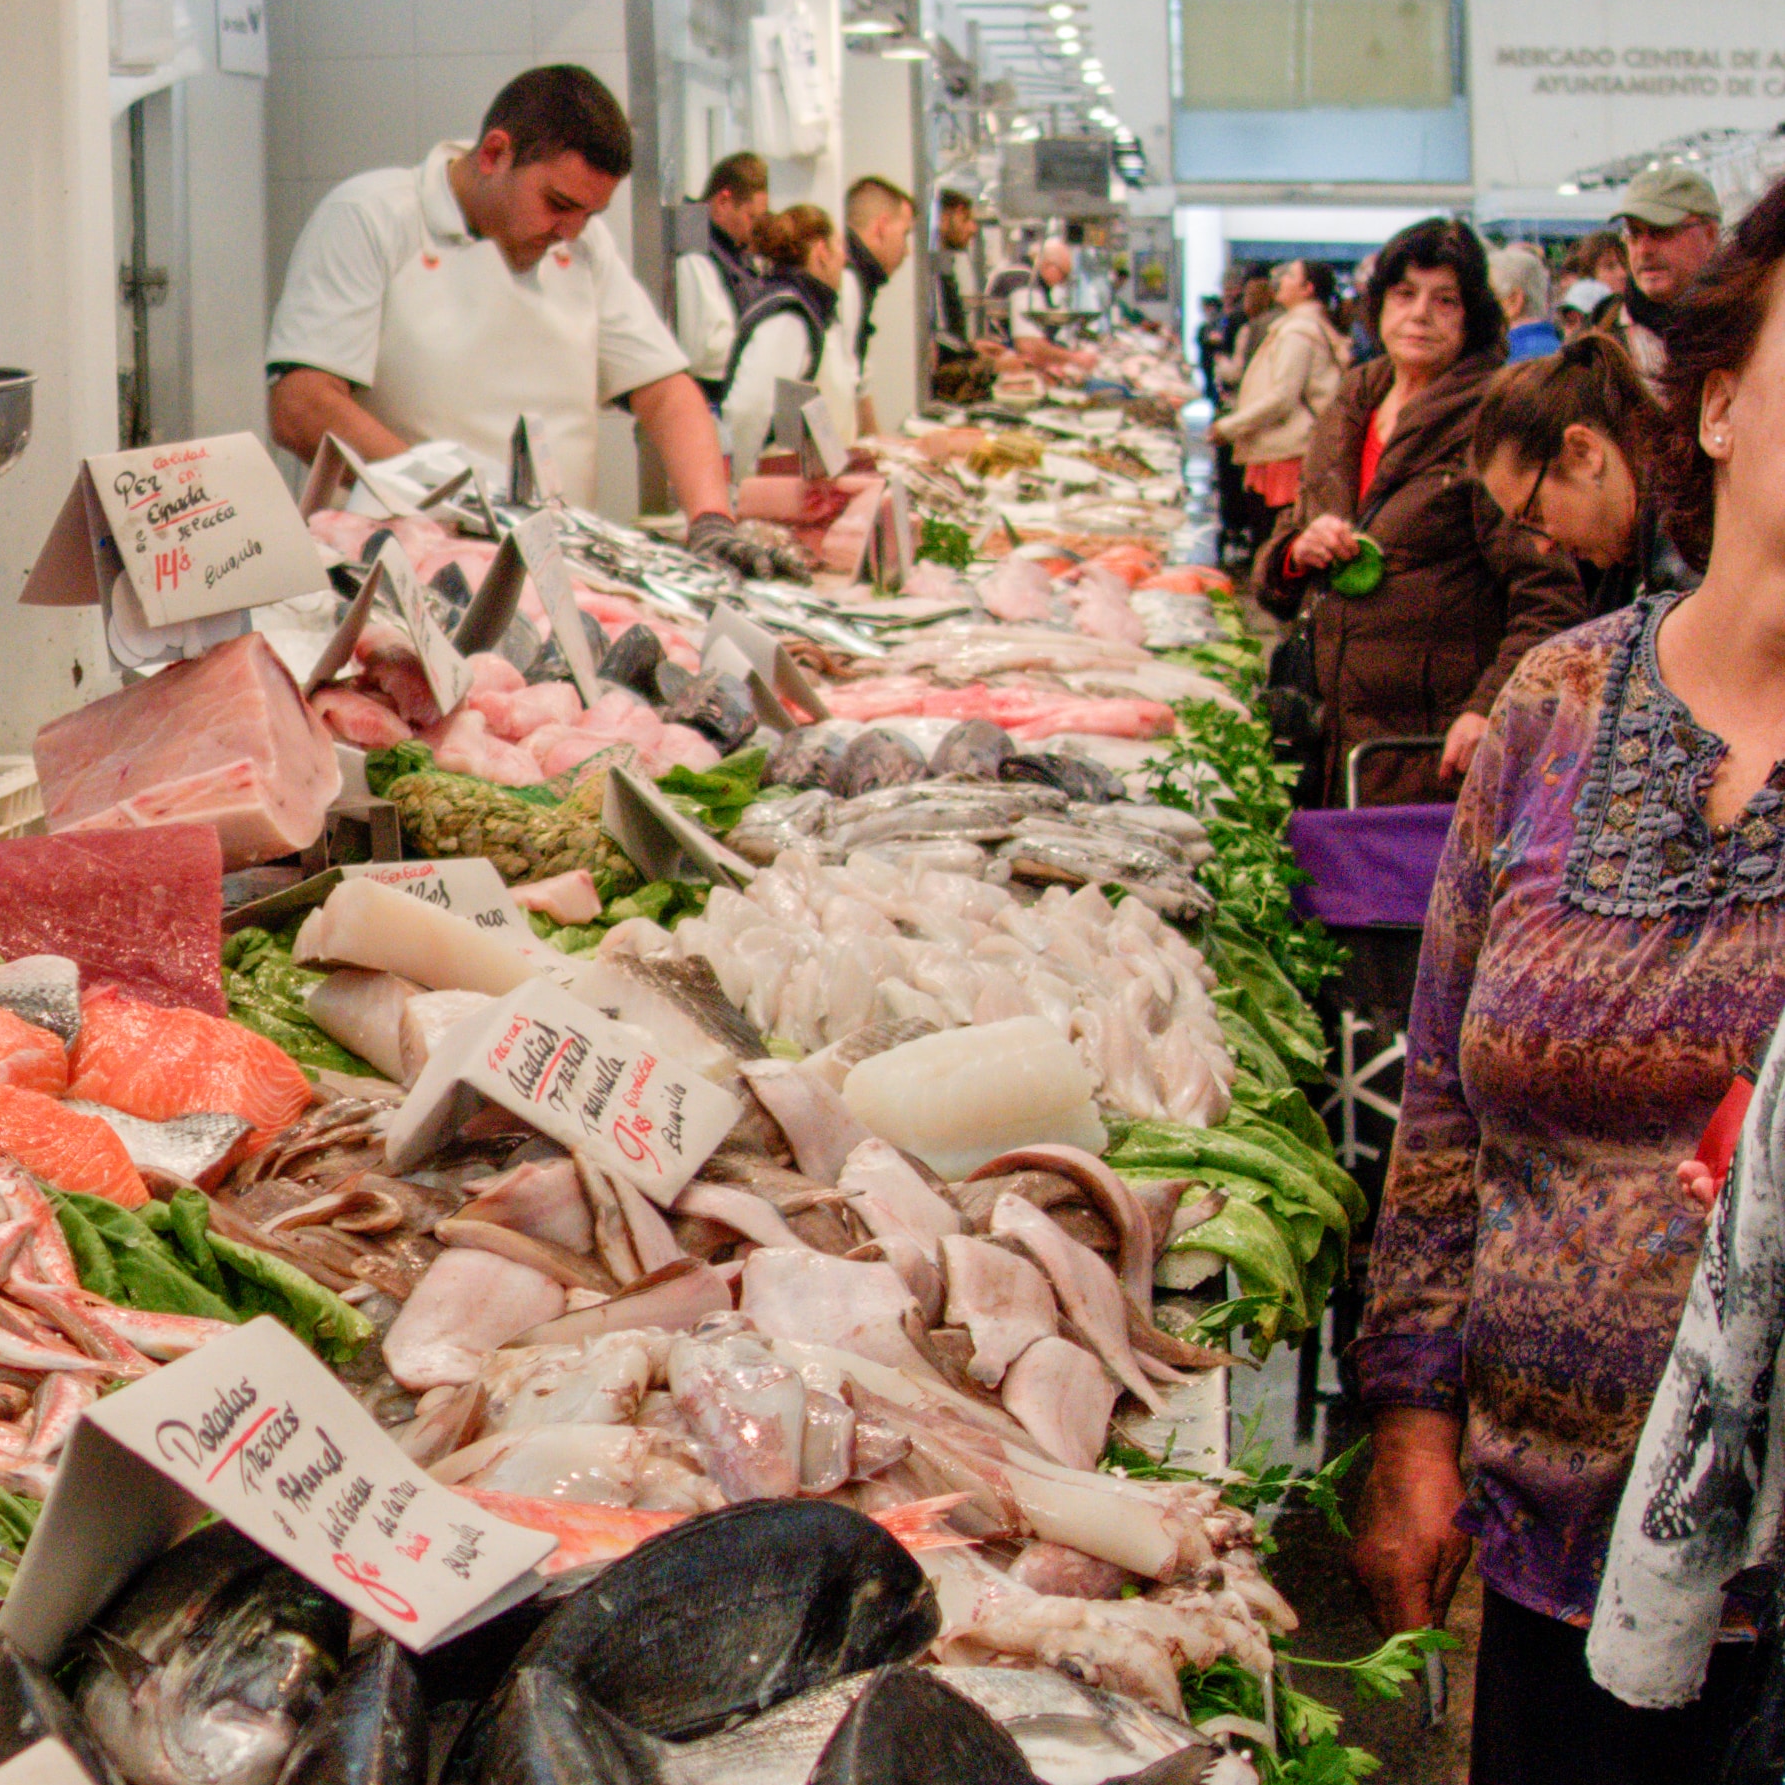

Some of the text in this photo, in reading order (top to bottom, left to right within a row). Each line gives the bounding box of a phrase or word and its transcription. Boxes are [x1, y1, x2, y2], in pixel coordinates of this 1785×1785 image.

[1496, 46, 1616, 67] MERCADO
[1622, 47, 1720, 68] CENTRAL
[1730, 48, 1760, 69] DE
[1532, 74, 1721, 96] AYUNTAMIENTO
[1726, 76, 1756, 97] DE
